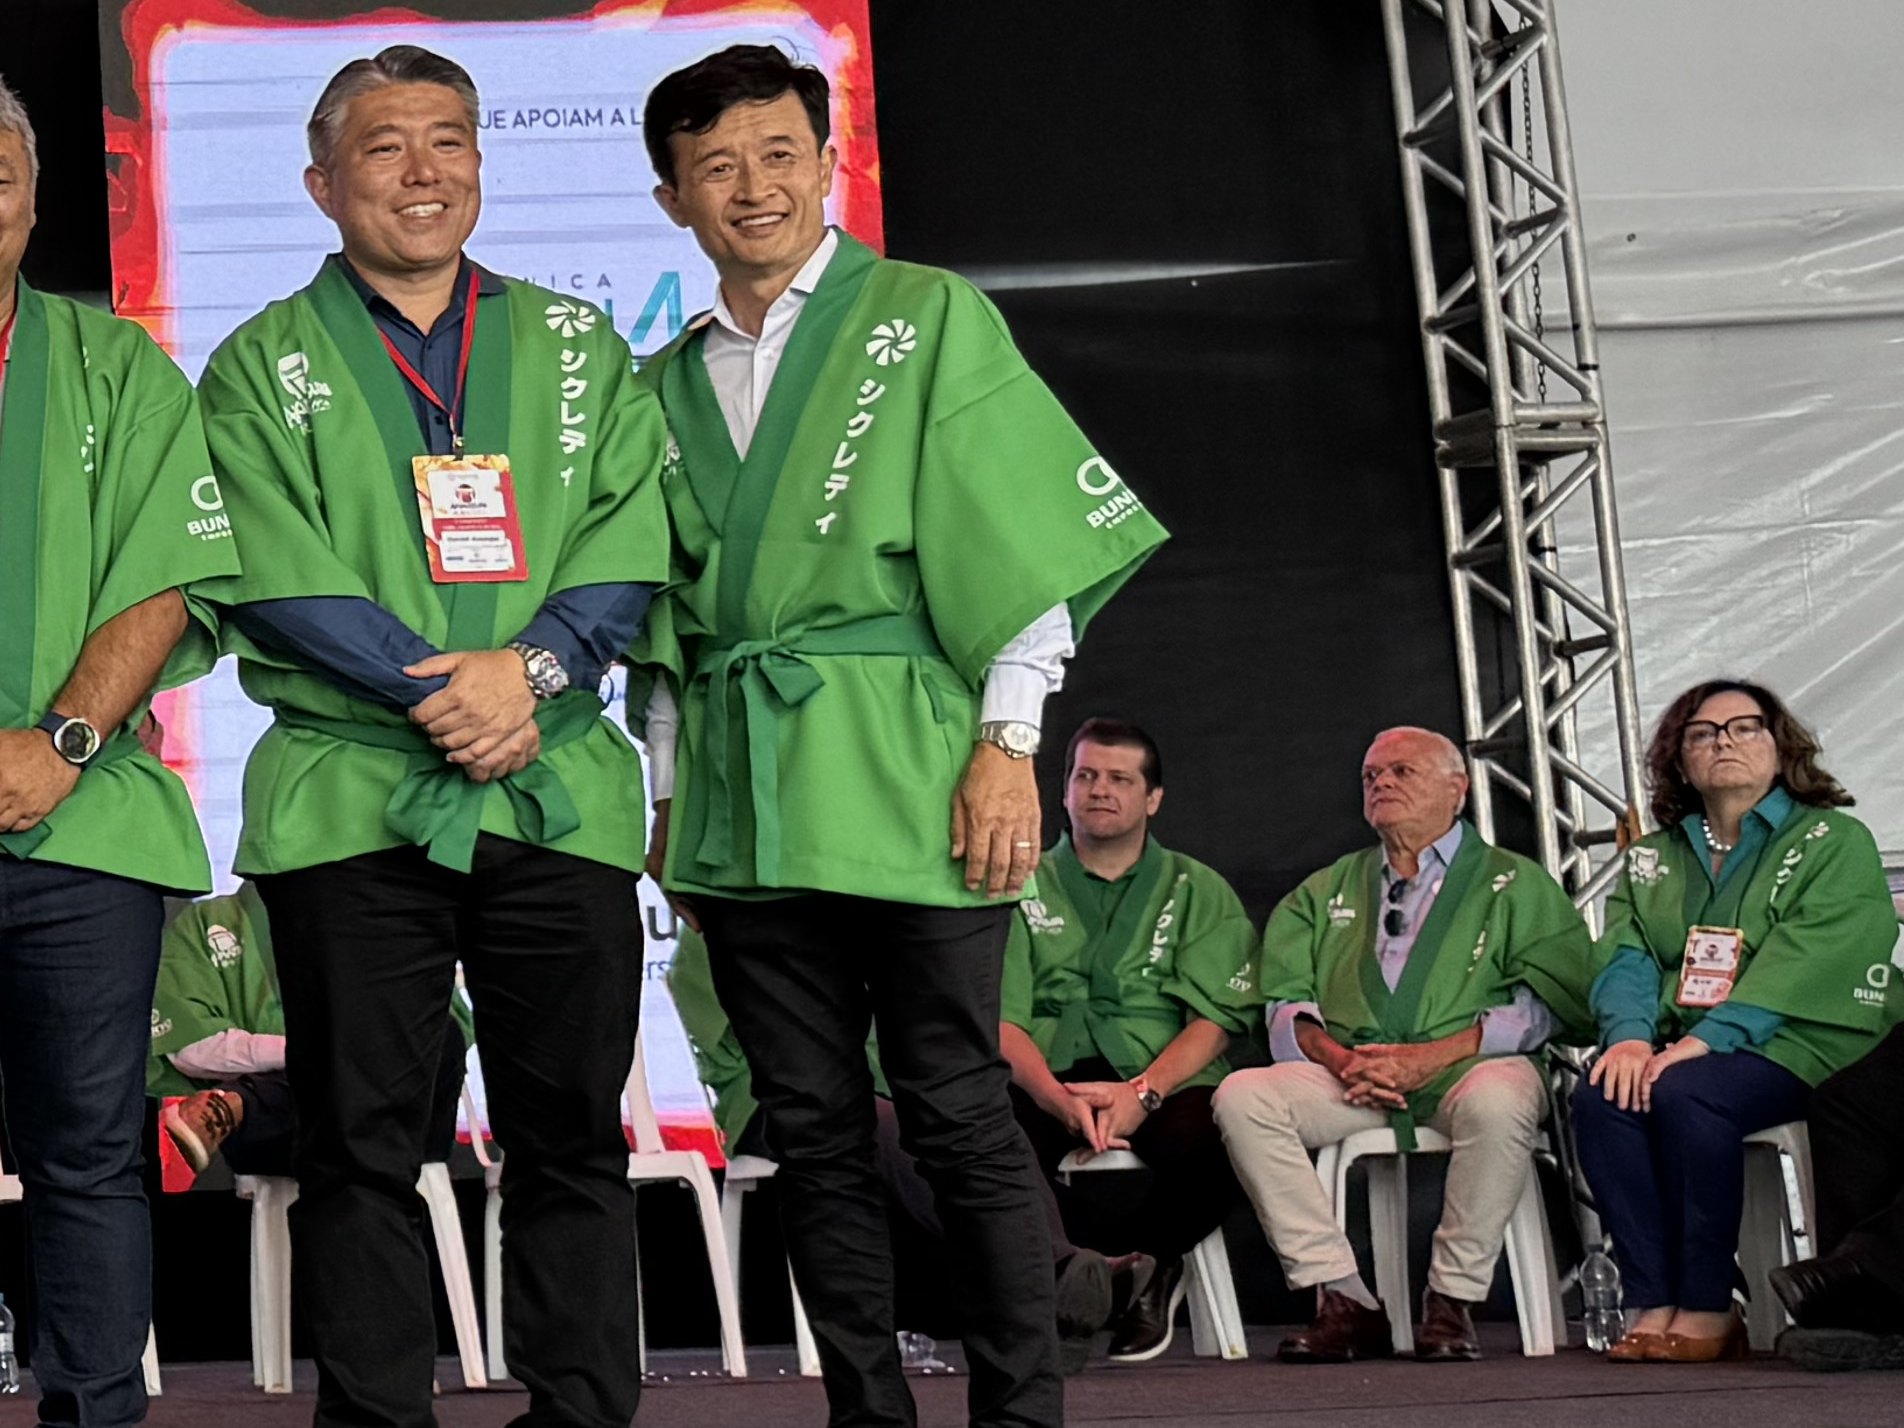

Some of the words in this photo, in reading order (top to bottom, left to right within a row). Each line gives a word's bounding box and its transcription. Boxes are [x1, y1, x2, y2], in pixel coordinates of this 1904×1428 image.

[478, 110, 507, 129] UE
[512, 108, 603, 129] APOIAM
[610, 108, 626, 125] A
[1086, 491, 1133, 529] BUN
[187, 513, 230, 535] BUN
[1853, 987, 1886, 1002] BUN
